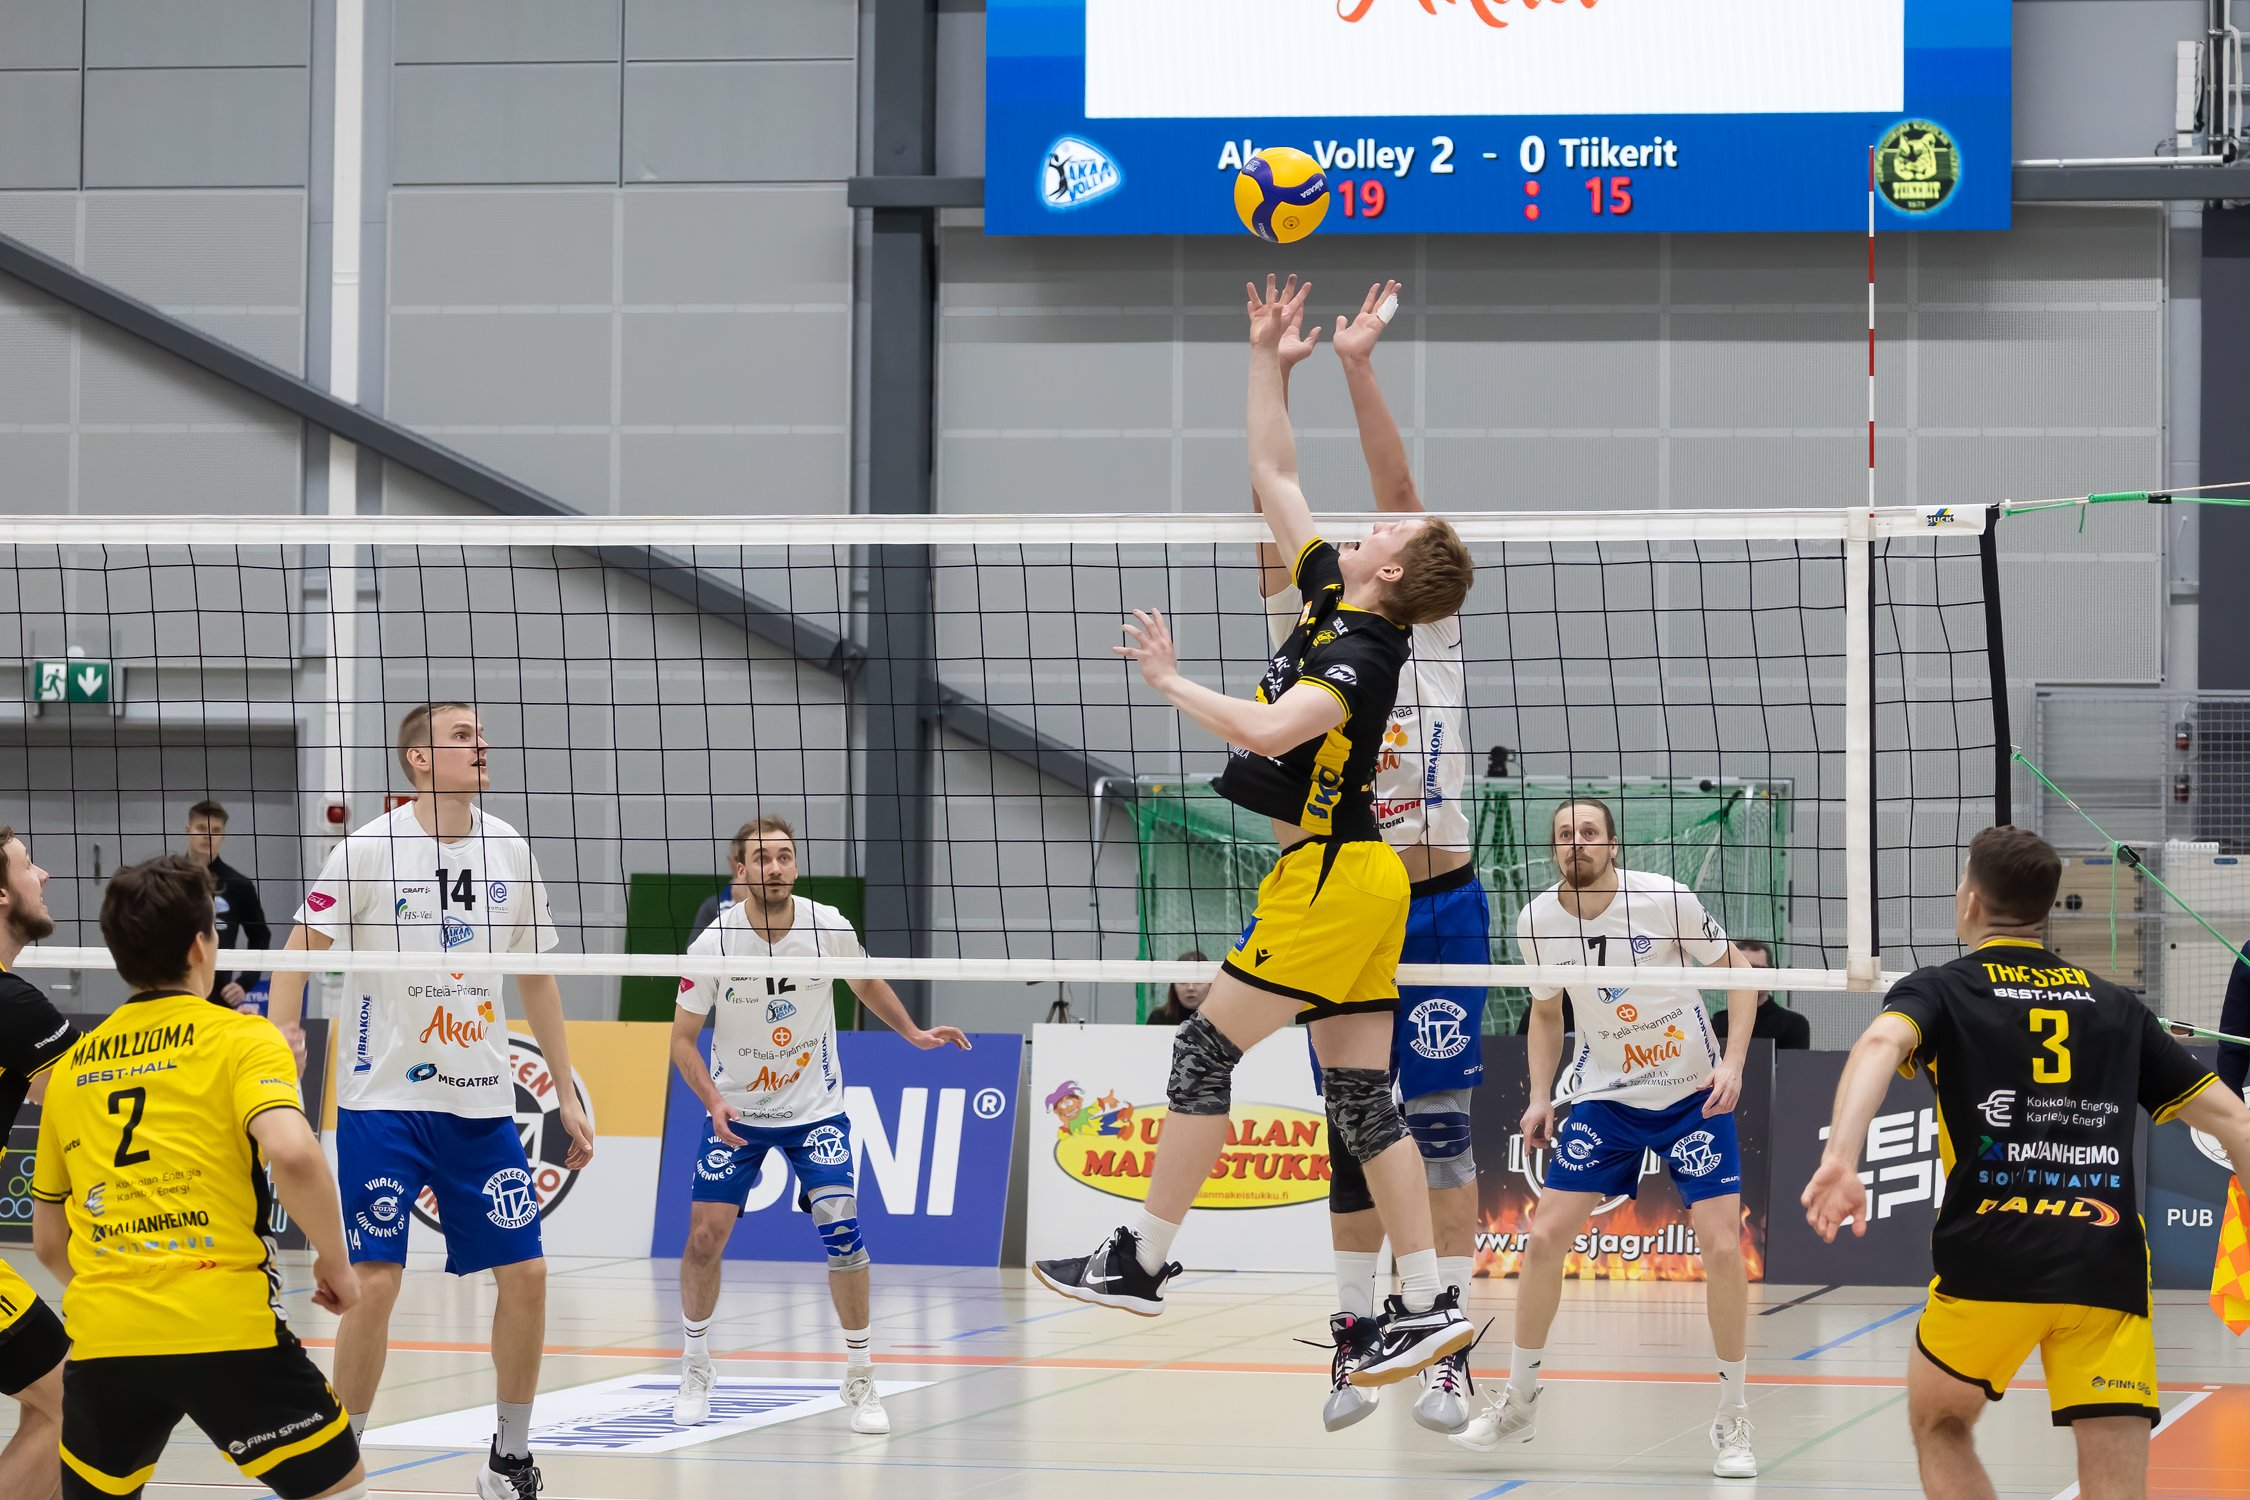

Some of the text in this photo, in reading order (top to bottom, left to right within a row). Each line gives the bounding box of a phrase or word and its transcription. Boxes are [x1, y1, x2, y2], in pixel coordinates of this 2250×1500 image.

[1218, 140, 1262, 170] Ak
[1313, 138, 1414, 177] Volley
[1430, 136, 1454, 173] 2
[1520, 135, 1545, 172] 0
[1559, 136, 1678, 167] Tiikerit
[1338, 179, 1386, 217] 19
[1586, 176, 1632, 214] 15
[435, 869, 476, 911] 14
[1587, 935, 1607, 967] 7
[408, 985, 423, 998] OP
[1414, 1002, 1461, 1019] HÄMEEN
[1612, 1007, 1684, 1040] telä-Pirkanmaa
[70, 1023, 194, 1070] MÄKILUOMA
[739, 1048, 751, 1057] OP
[1413, 1037, 1469, 1058] TURISTIAUTO
[2029, 1008, 2072, 1084] 3
[1622, 1040, 1682, 1074] Akaa
[438, 1073, 499, 1088] MEGATREX
[1687, 1072, 1699, 1082] OY
[2027, 1096, 2119, 1114] Kokkolan Energia
[107, 1086, 150, 1168] 2
[2027, 1111, 2106, 1128] Karleby Energi
[1571, 1122, 1603, 1146] VIIALAN
[2008, 1141, 2119, 1165] RAUANHEIMO
[364, 1177, 405, 1195] VIIALAN
[487, 1170, 527, 1191] HÄMEEN
[372, 1205, 397, 1213] VOLVO
[489, 1202, 537, 1228] TURISTIAUTO
[2167, 1208, 2213, 1227] PUB
[356, 1211, 398, 1238] LIIKENNE
[348, 1228, 361, 1250] 14
[2108, 1380, 2135, 1389] FINN
[247, 1431, 276, 1448] FINN
